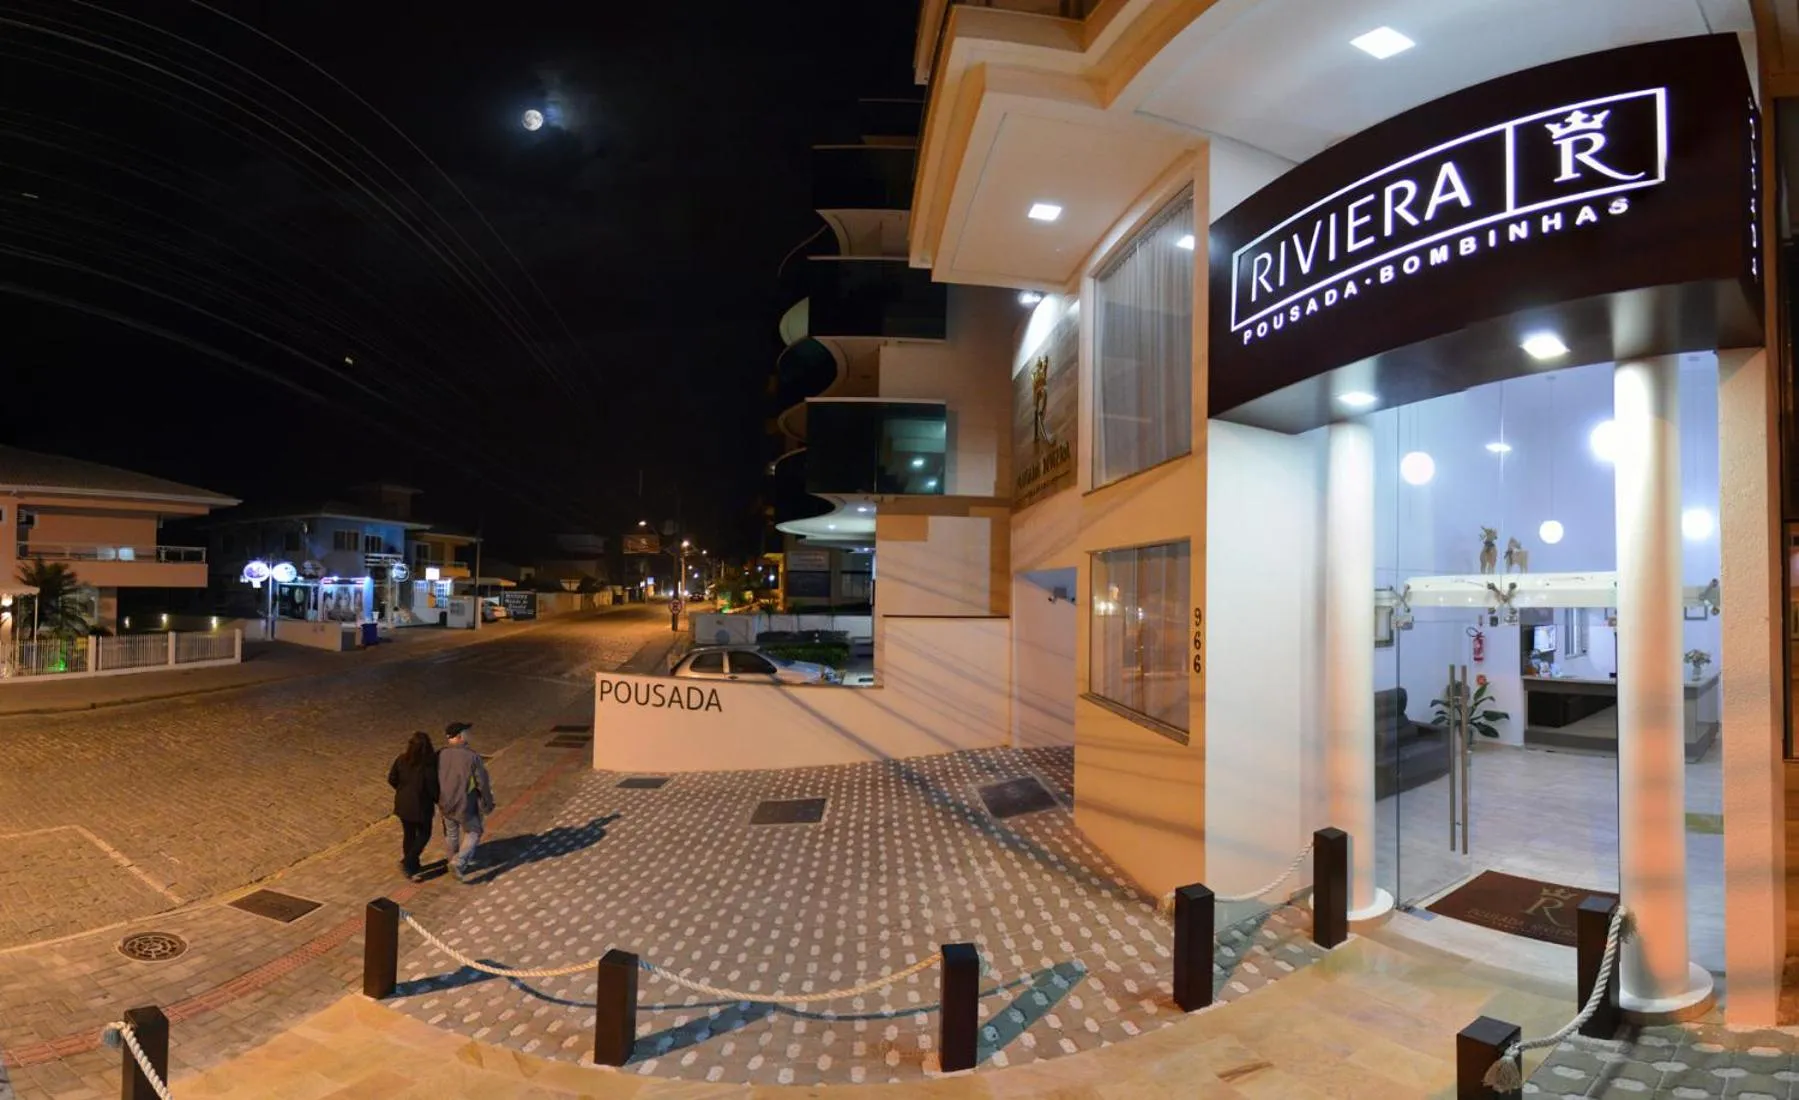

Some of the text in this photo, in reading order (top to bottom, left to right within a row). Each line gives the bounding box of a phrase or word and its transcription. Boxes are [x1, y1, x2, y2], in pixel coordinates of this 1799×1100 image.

[1250, 131, 1646, 303] RIVIERA R
[1243, 197, 1629, 345] POUSADA BOMBINHAS
[1193, 607, 1202, 674] 966
[599, 679, 723, 713] POUSADA
